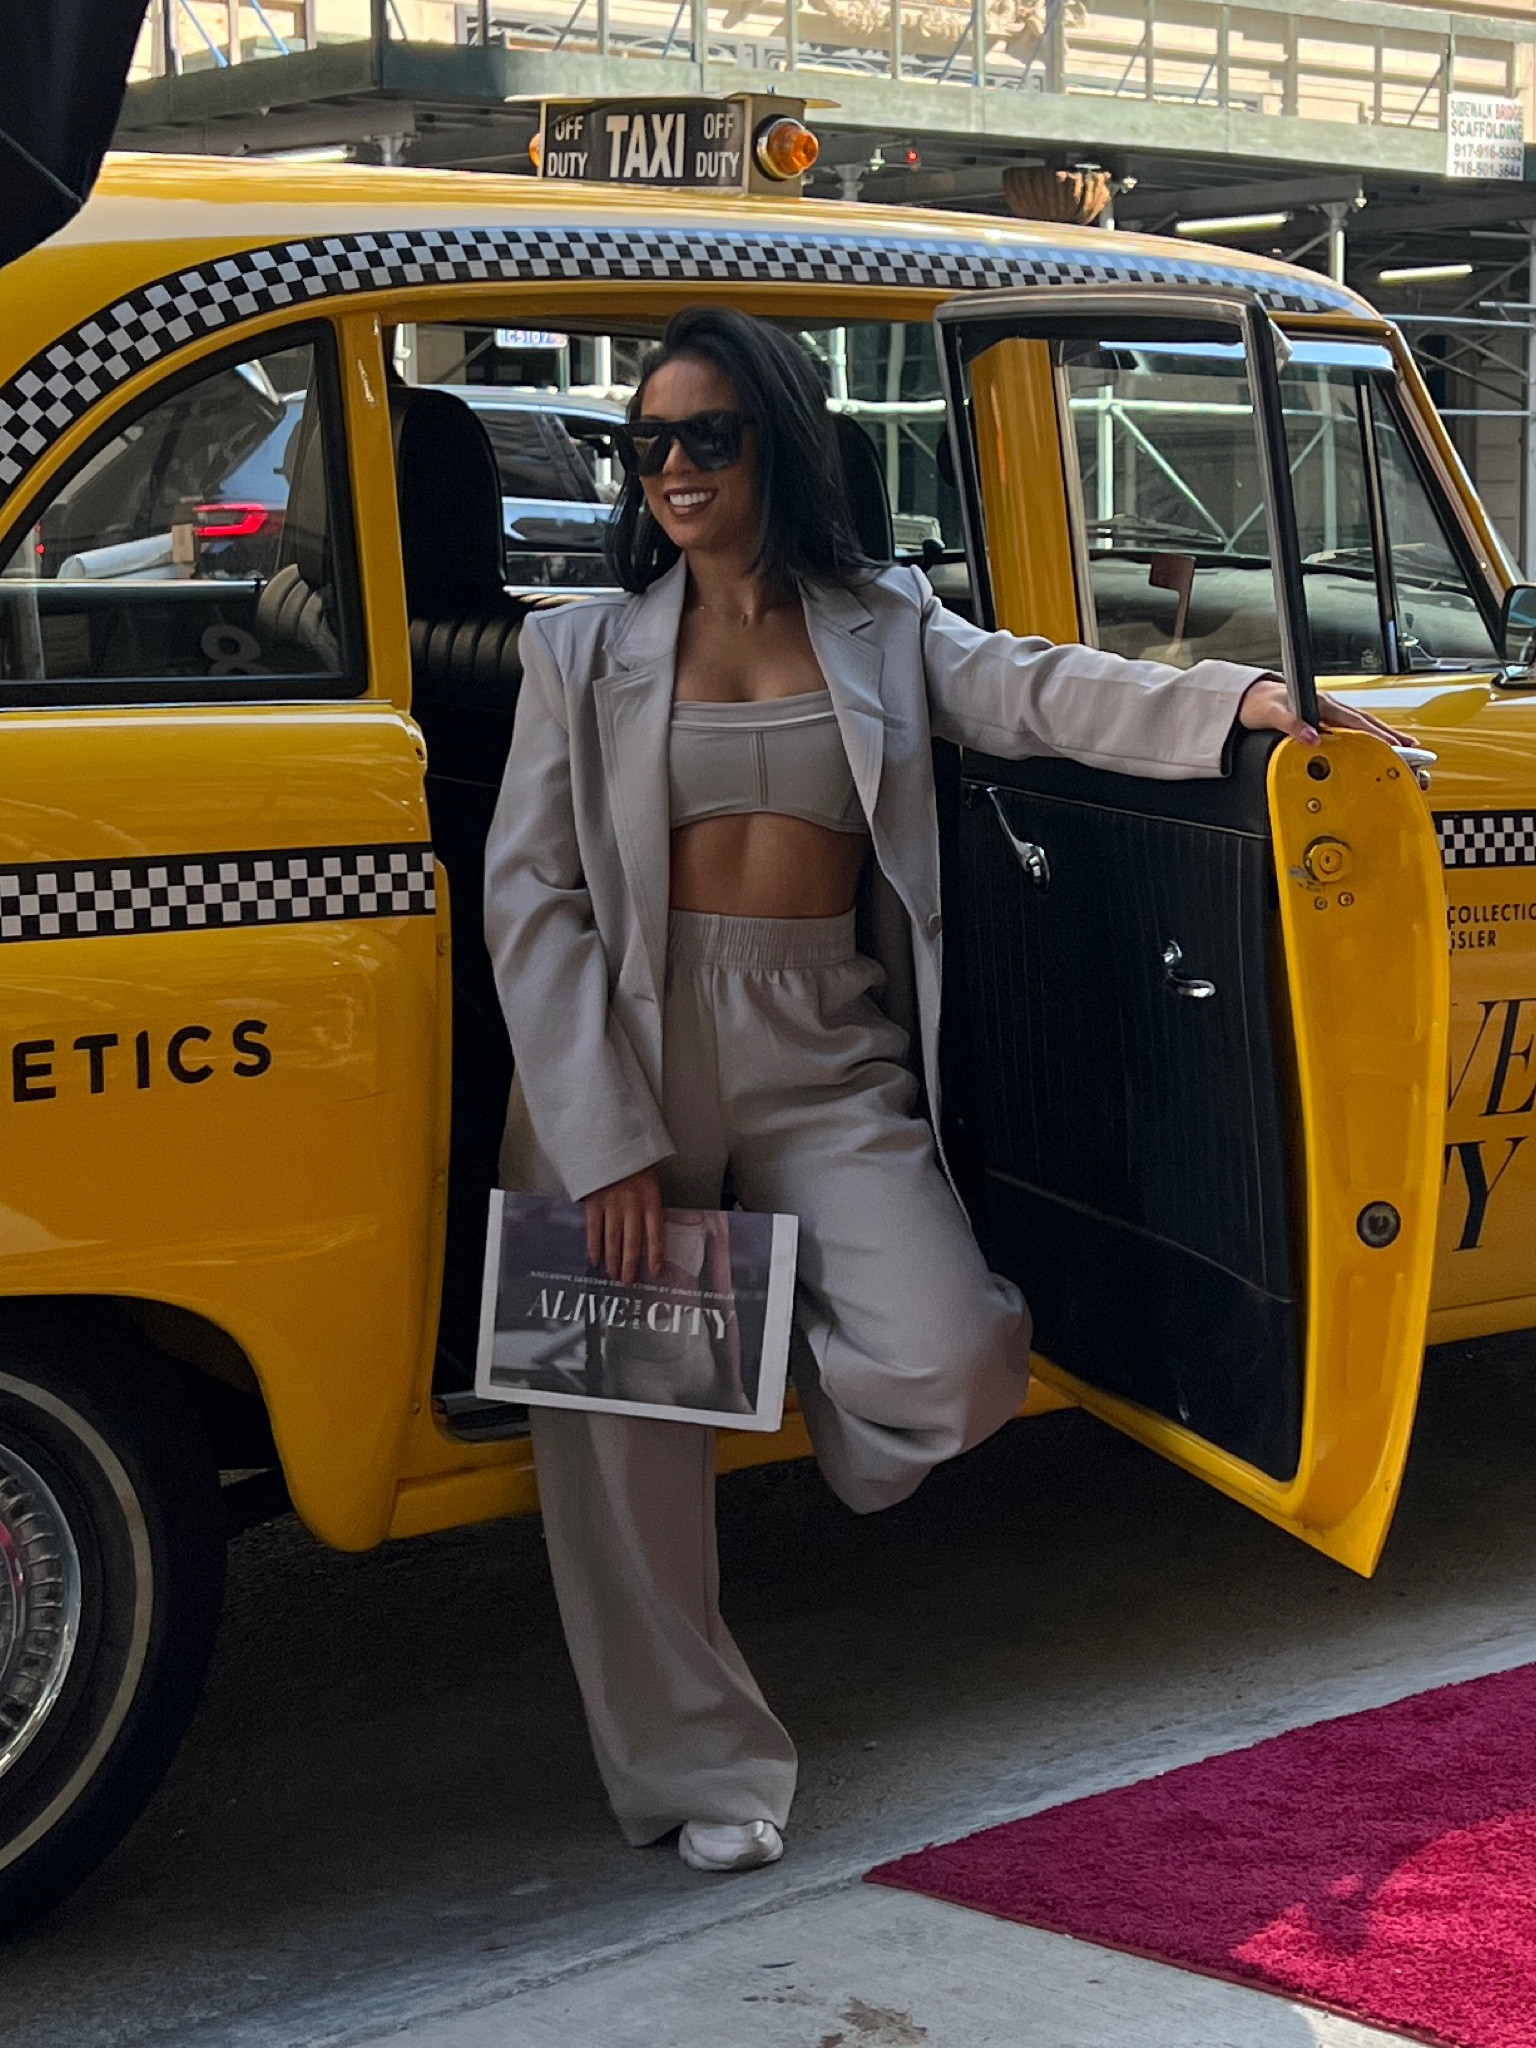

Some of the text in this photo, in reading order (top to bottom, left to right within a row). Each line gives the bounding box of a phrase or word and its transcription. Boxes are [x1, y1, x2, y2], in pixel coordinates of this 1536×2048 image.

[1450, 99, 1525, 122] SIDEWALK BRIDGE
[555, 114, 583, 141] OFF
[703, 112, 734, 140] OFF
[1450, 119, 1524, 141] SCAFFOLDING
[605, 113, 686, 179] TAXI
[548, 151, 588, 178] DUTY
[695, 151, 740, 179] DUTY
[12, 1019, 272, 1103] ETICS
[526, 1287, 631, 1328] ALIVE
[647, 1301, 736, 1340] CITY
